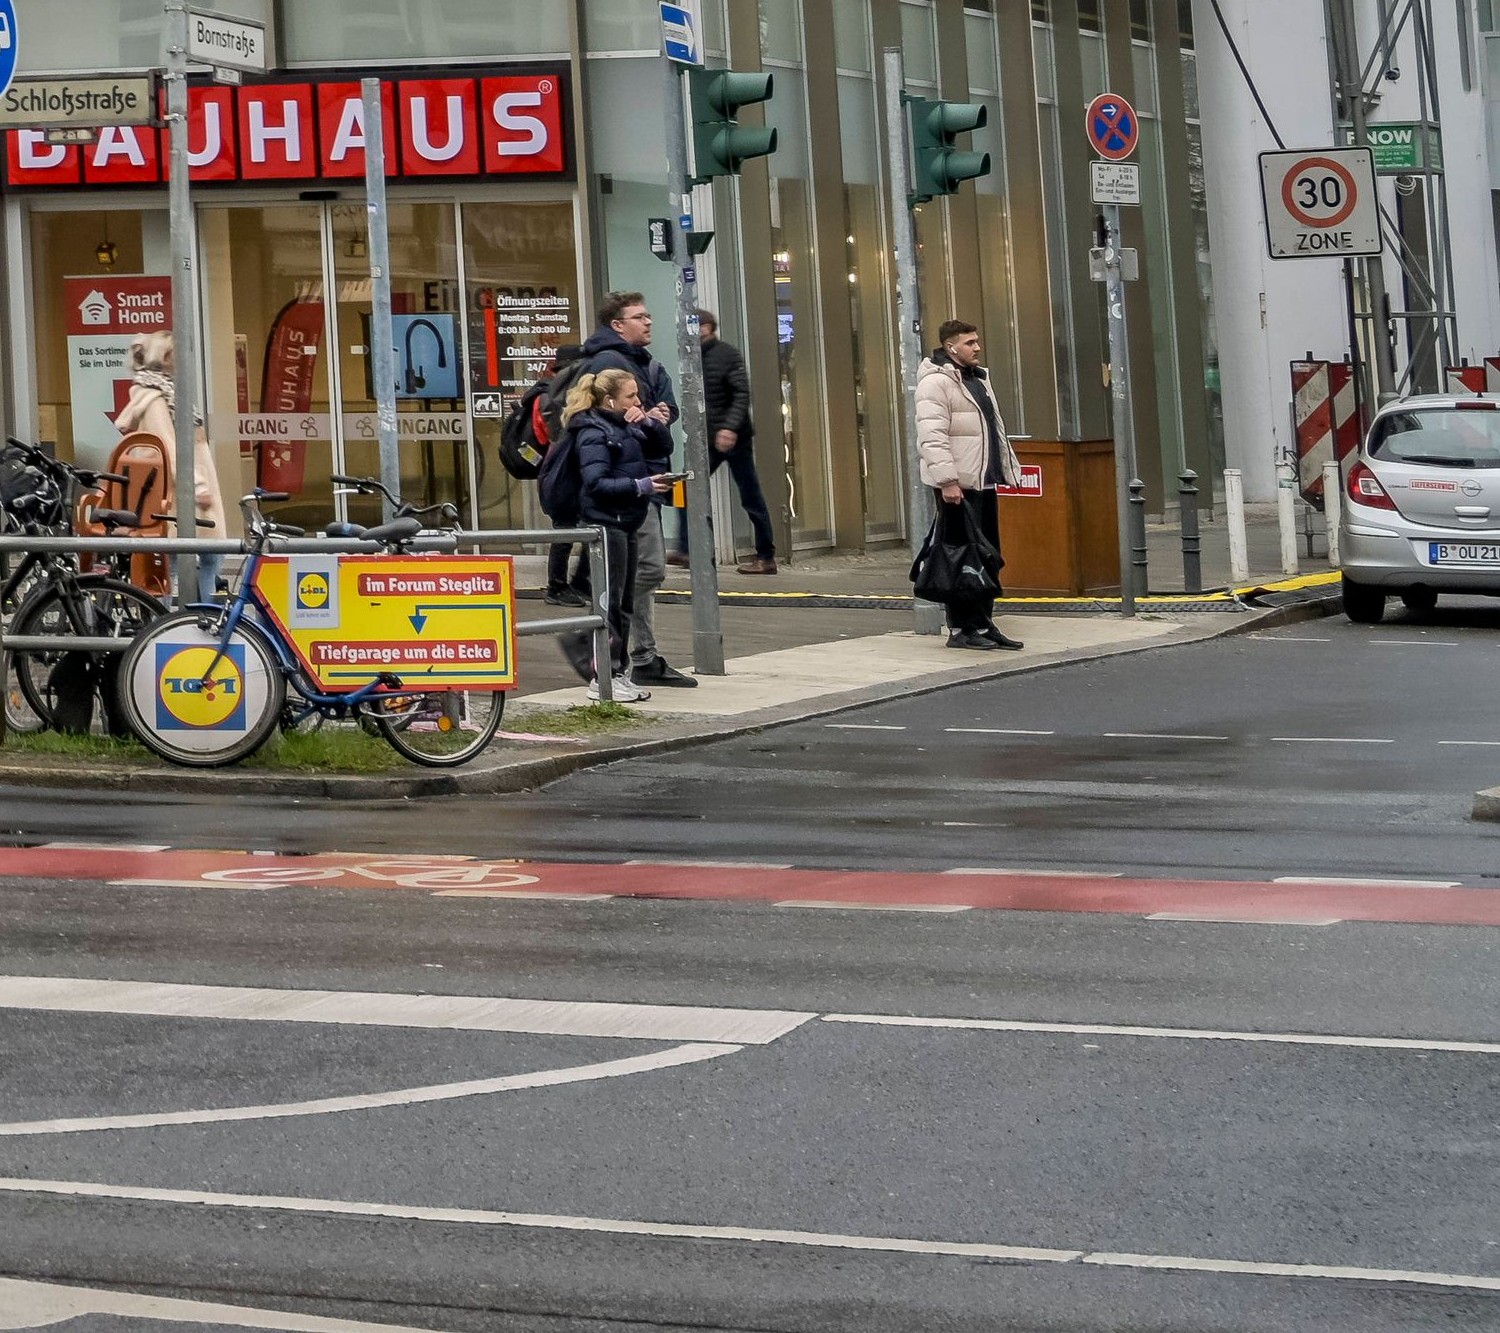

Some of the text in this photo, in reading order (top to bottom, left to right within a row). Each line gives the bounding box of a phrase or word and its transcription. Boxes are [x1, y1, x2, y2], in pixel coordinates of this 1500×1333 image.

[197, 20, 255, 58] Bornstraße
[4, 85, 137, 116] Schloßstraße
[1296, 176, 1342, 209] 30
[1296, 231, 1354, 251] ZONE
[116, 291, 164, 307] Smart
[496, 295, 570, 308] Öffnungszeiten
[117, 309, 165, 324] Home
[499, 313, 530, 323] Montag
[535, 313, 569, 323] Samstag
[556, 325, 571, 334] Uhr
[78, 346, 129, 356] Das Sortime
[506, 345, 558, 358] Online-Sh
[79, 360, 92, 368] Sie
[527, 362, 548, 372] 24/7
[1411, 481, 1456, 491] LIEFERSERVICE
[1439, 545, 1500, 560] B OU 21
[300, 584, 326, 595] LIDL
[365, 576, 495, 596] im Forum Steglitz
[317, 644, 492, 664] Tiefgarage um die Ecke
